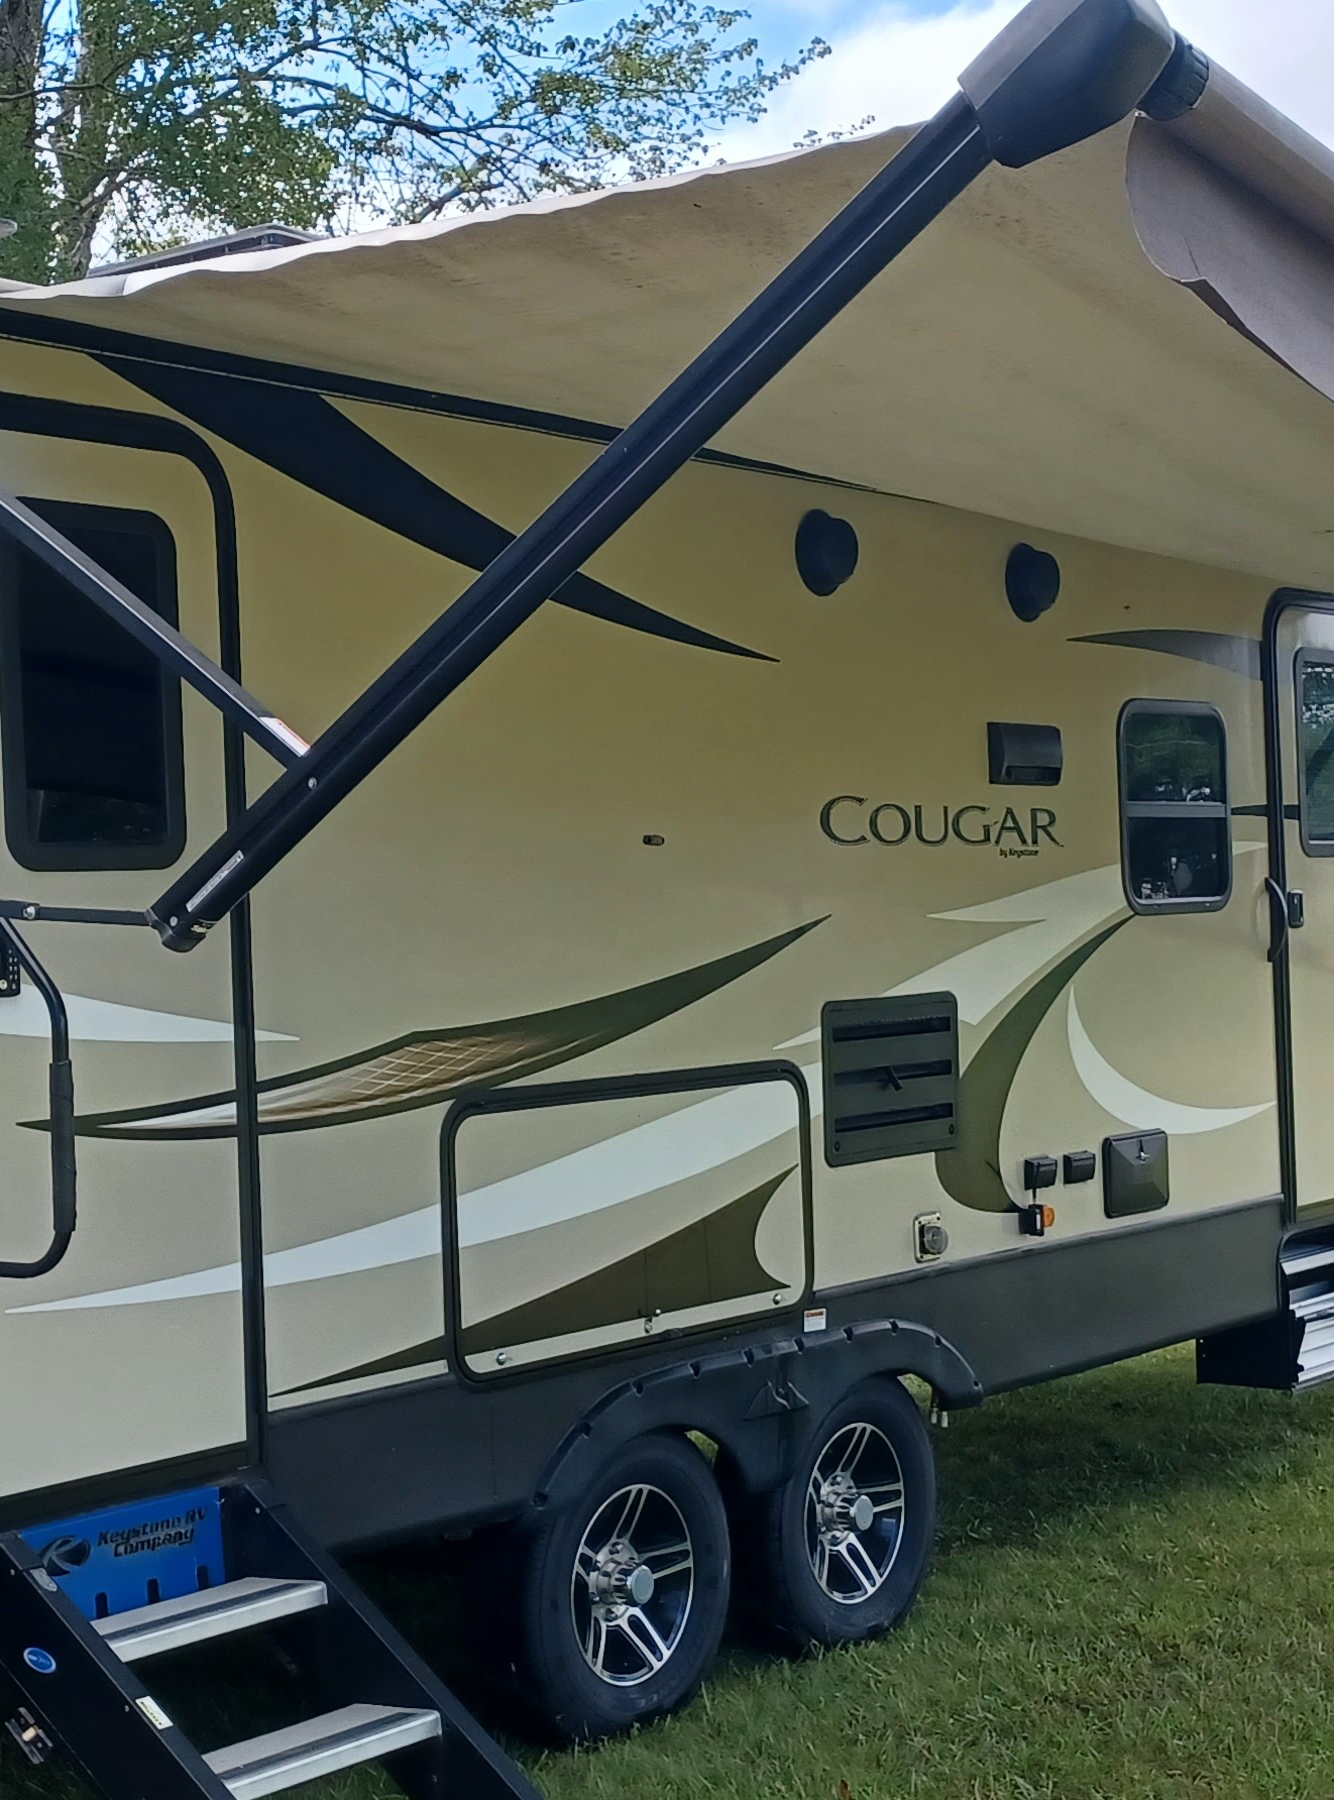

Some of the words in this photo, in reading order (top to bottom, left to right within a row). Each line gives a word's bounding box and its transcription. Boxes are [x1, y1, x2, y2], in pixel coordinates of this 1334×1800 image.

[819, 795, 1064, 848] COUGAR
[97, 1516, 181, 1547] Keystone
[184, 1506, 208, 1525] RV
[113, 1528, 195, 1557] Company
